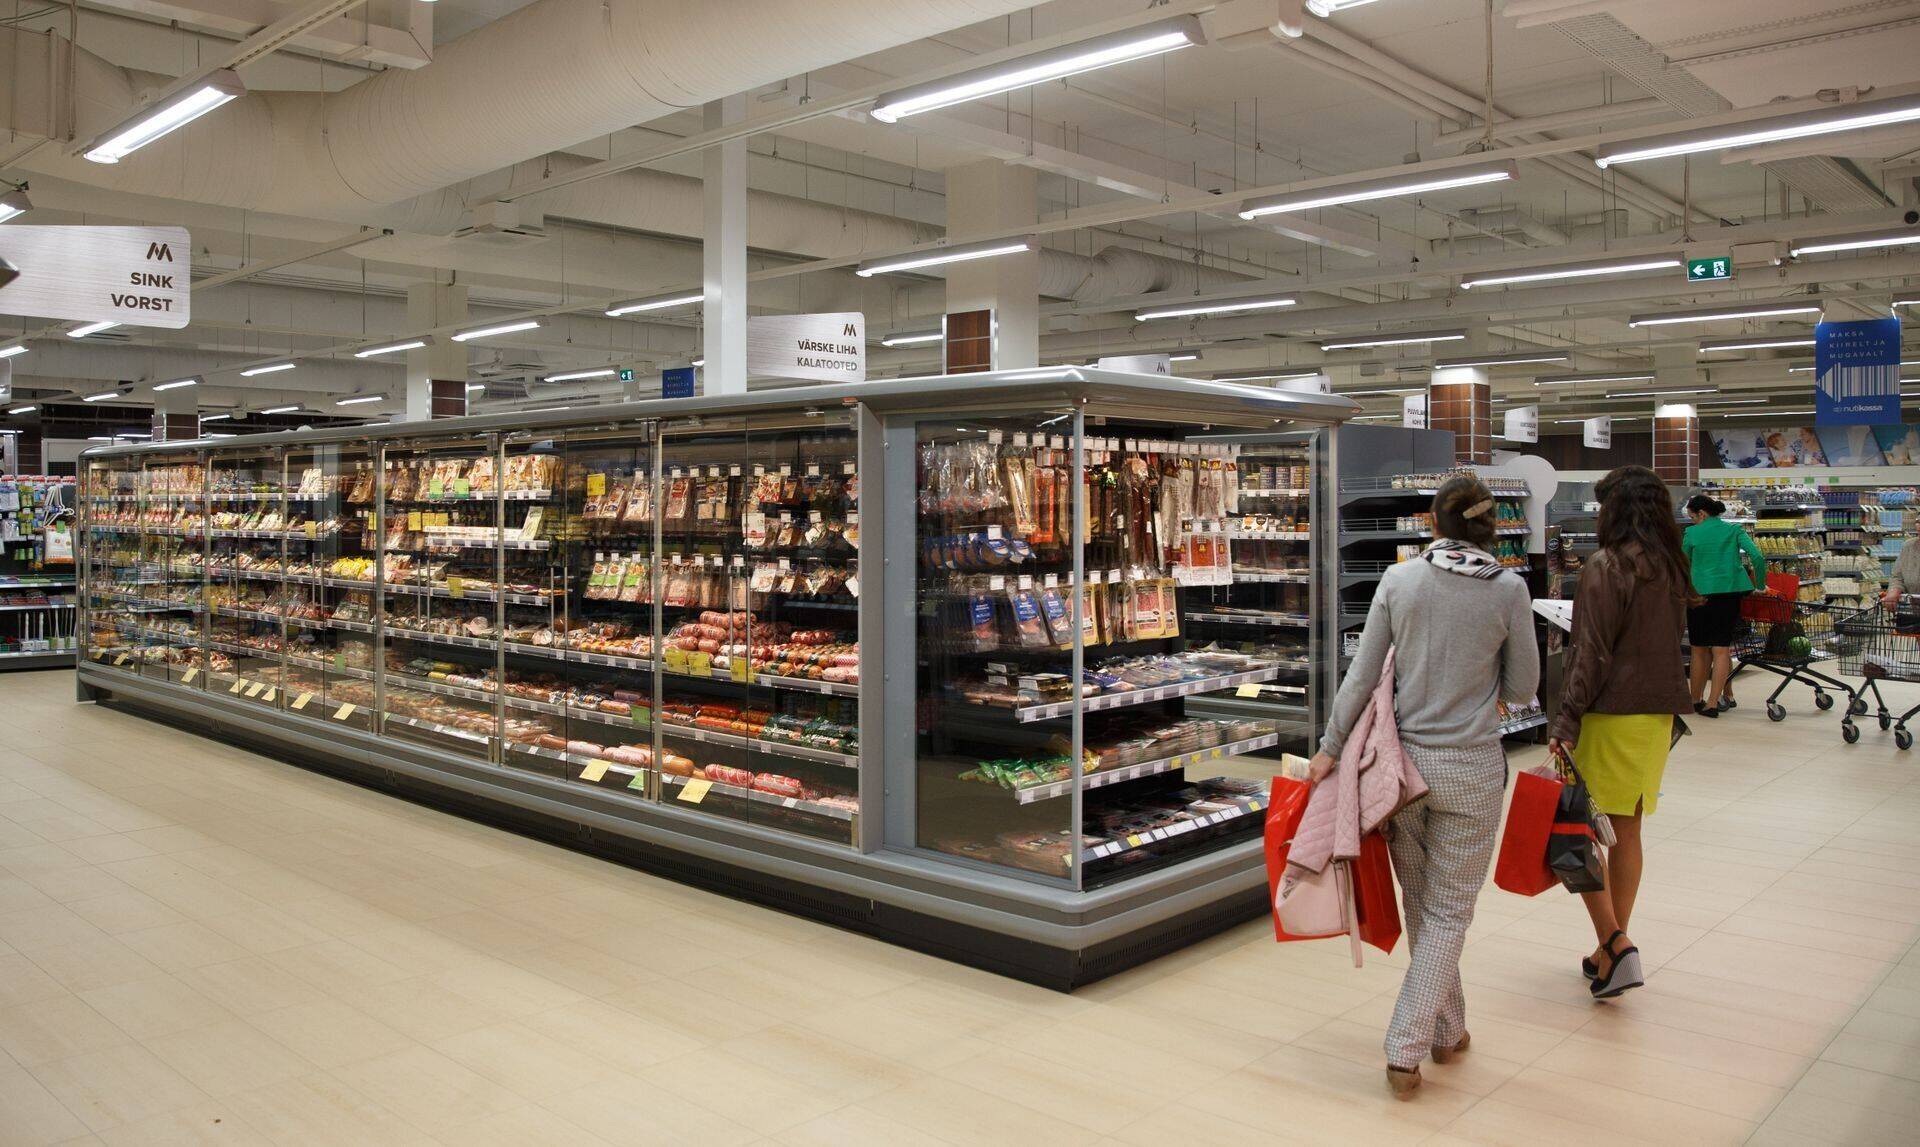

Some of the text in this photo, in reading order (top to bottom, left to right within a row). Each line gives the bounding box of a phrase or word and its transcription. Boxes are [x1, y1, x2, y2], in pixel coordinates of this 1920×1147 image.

[130, 272, 174, 289] SINK
[110, 293, 173, 312] VORST
[1829, 330, 1864, 338] MAKSA
[797, 338, 858, 355] VÄRSKE LIHA
[1829, 341, 1870, 349] KIIRELT
[1829, 351, 1884, 359] MUGAVALT
[797, 356, 858, 371] KALATOOTED
